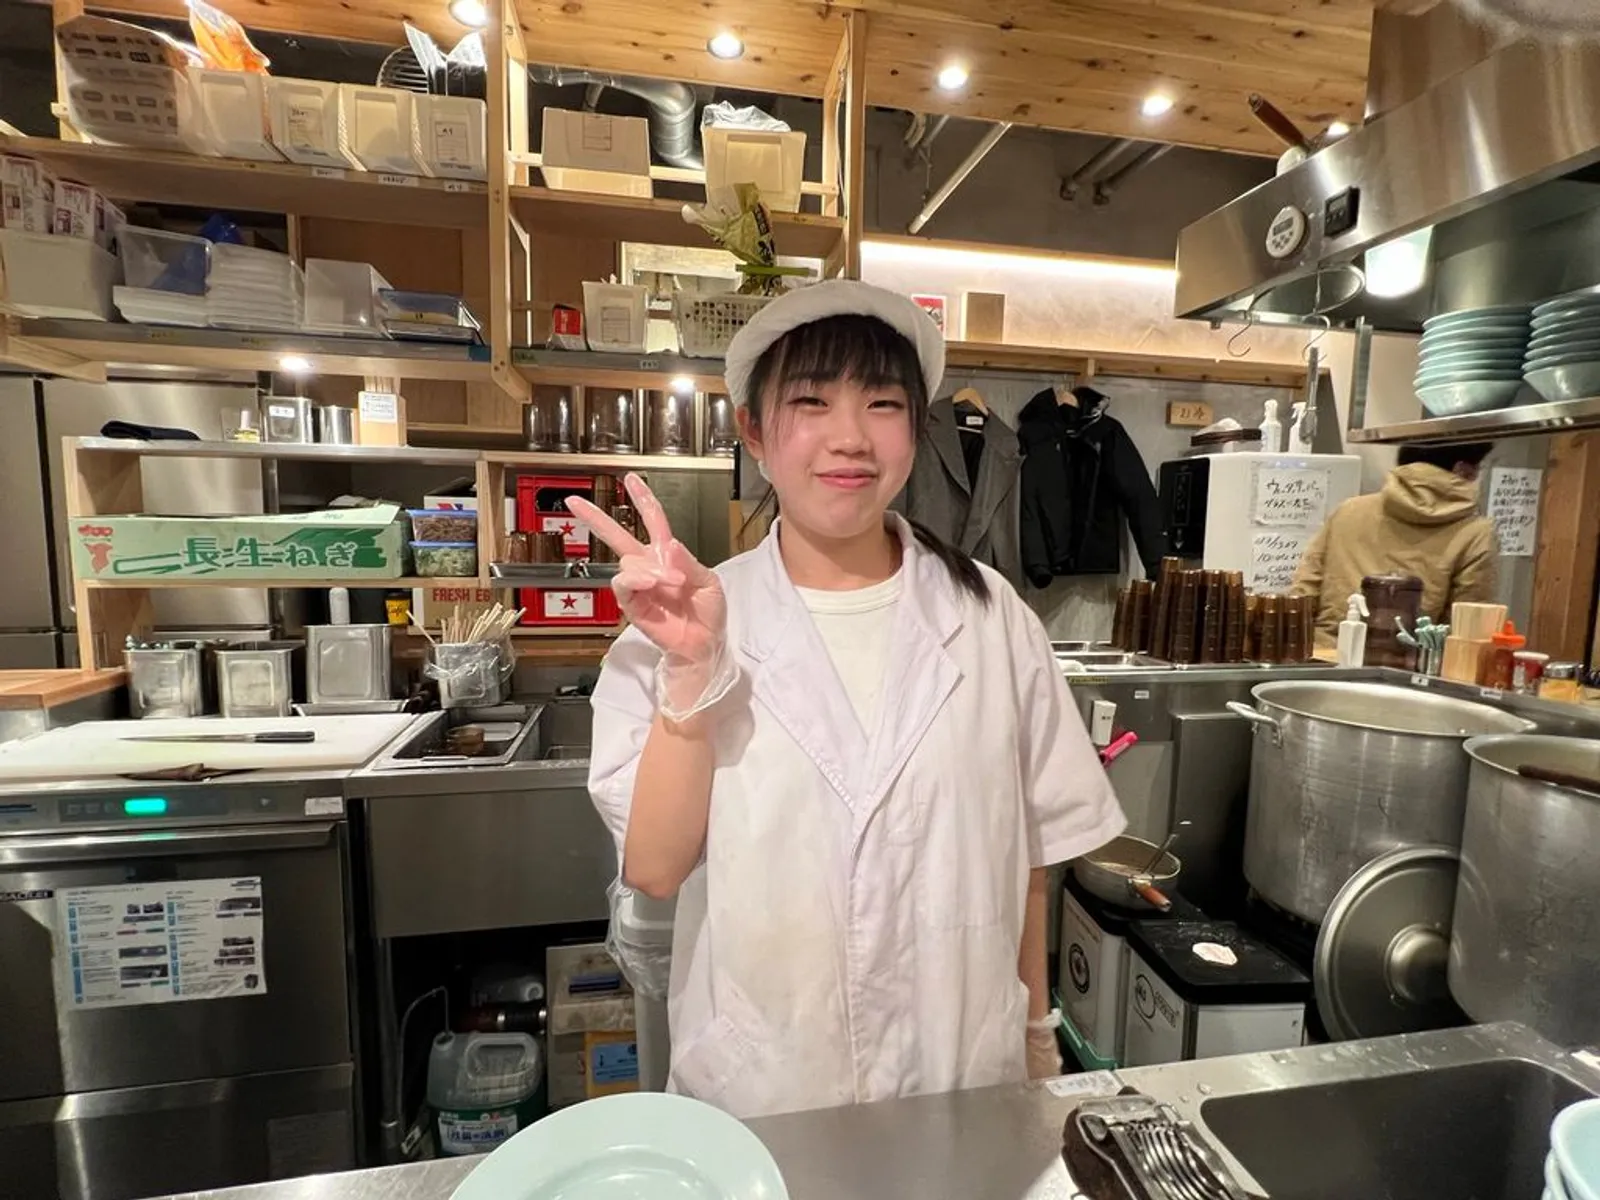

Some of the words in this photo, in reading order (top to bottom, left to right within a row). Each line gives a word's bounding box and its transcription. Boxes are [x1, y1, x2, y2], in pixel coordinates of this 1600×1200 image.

[183, 537, 358, 568] 長生ねぎ
[432, 587, 470, 602] FRESH
